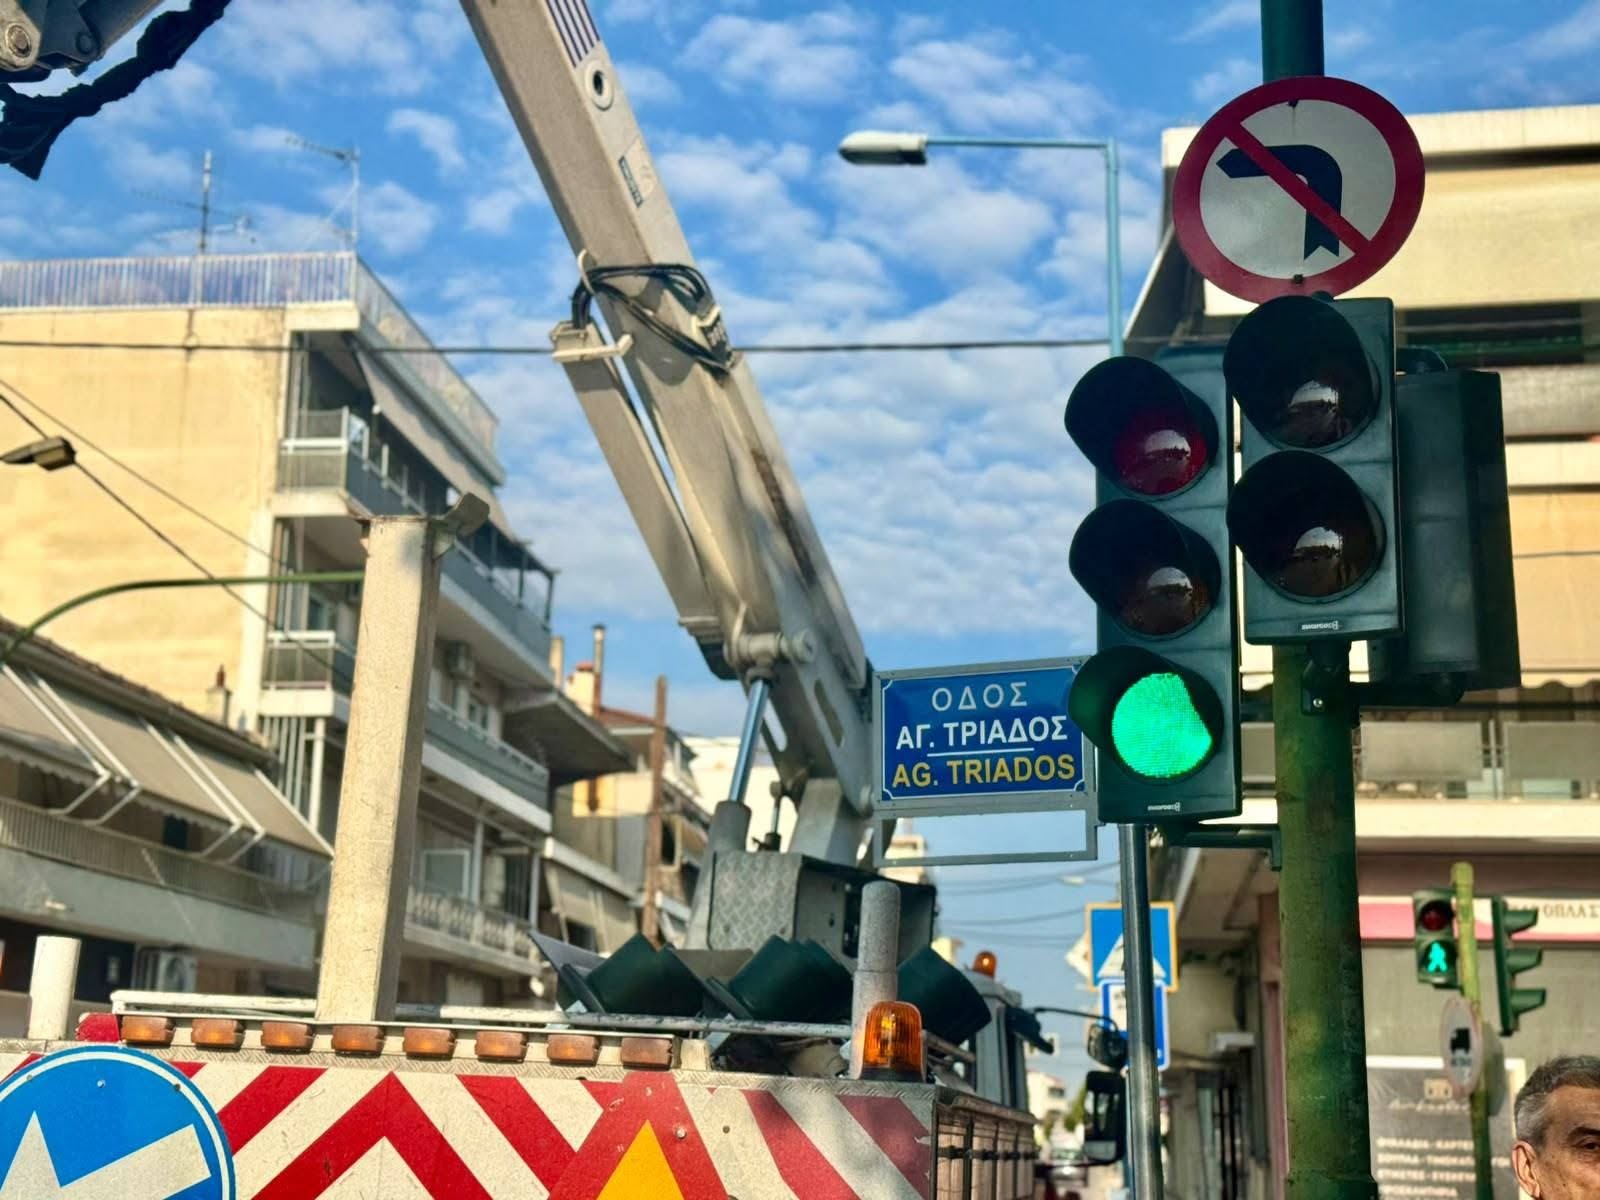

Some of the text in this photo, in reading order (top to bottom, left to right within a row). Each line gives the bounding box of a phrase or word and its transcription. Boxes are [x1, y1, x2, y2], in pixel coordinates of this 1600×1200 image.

[931, 681, 1028, 712] ΟΔΟΣ
[895, 715, 1068, 750] ΑΓ. ΤΡΙΑΔΟΣ
[891, 754, 1076, 788] AG. TRIADOS
